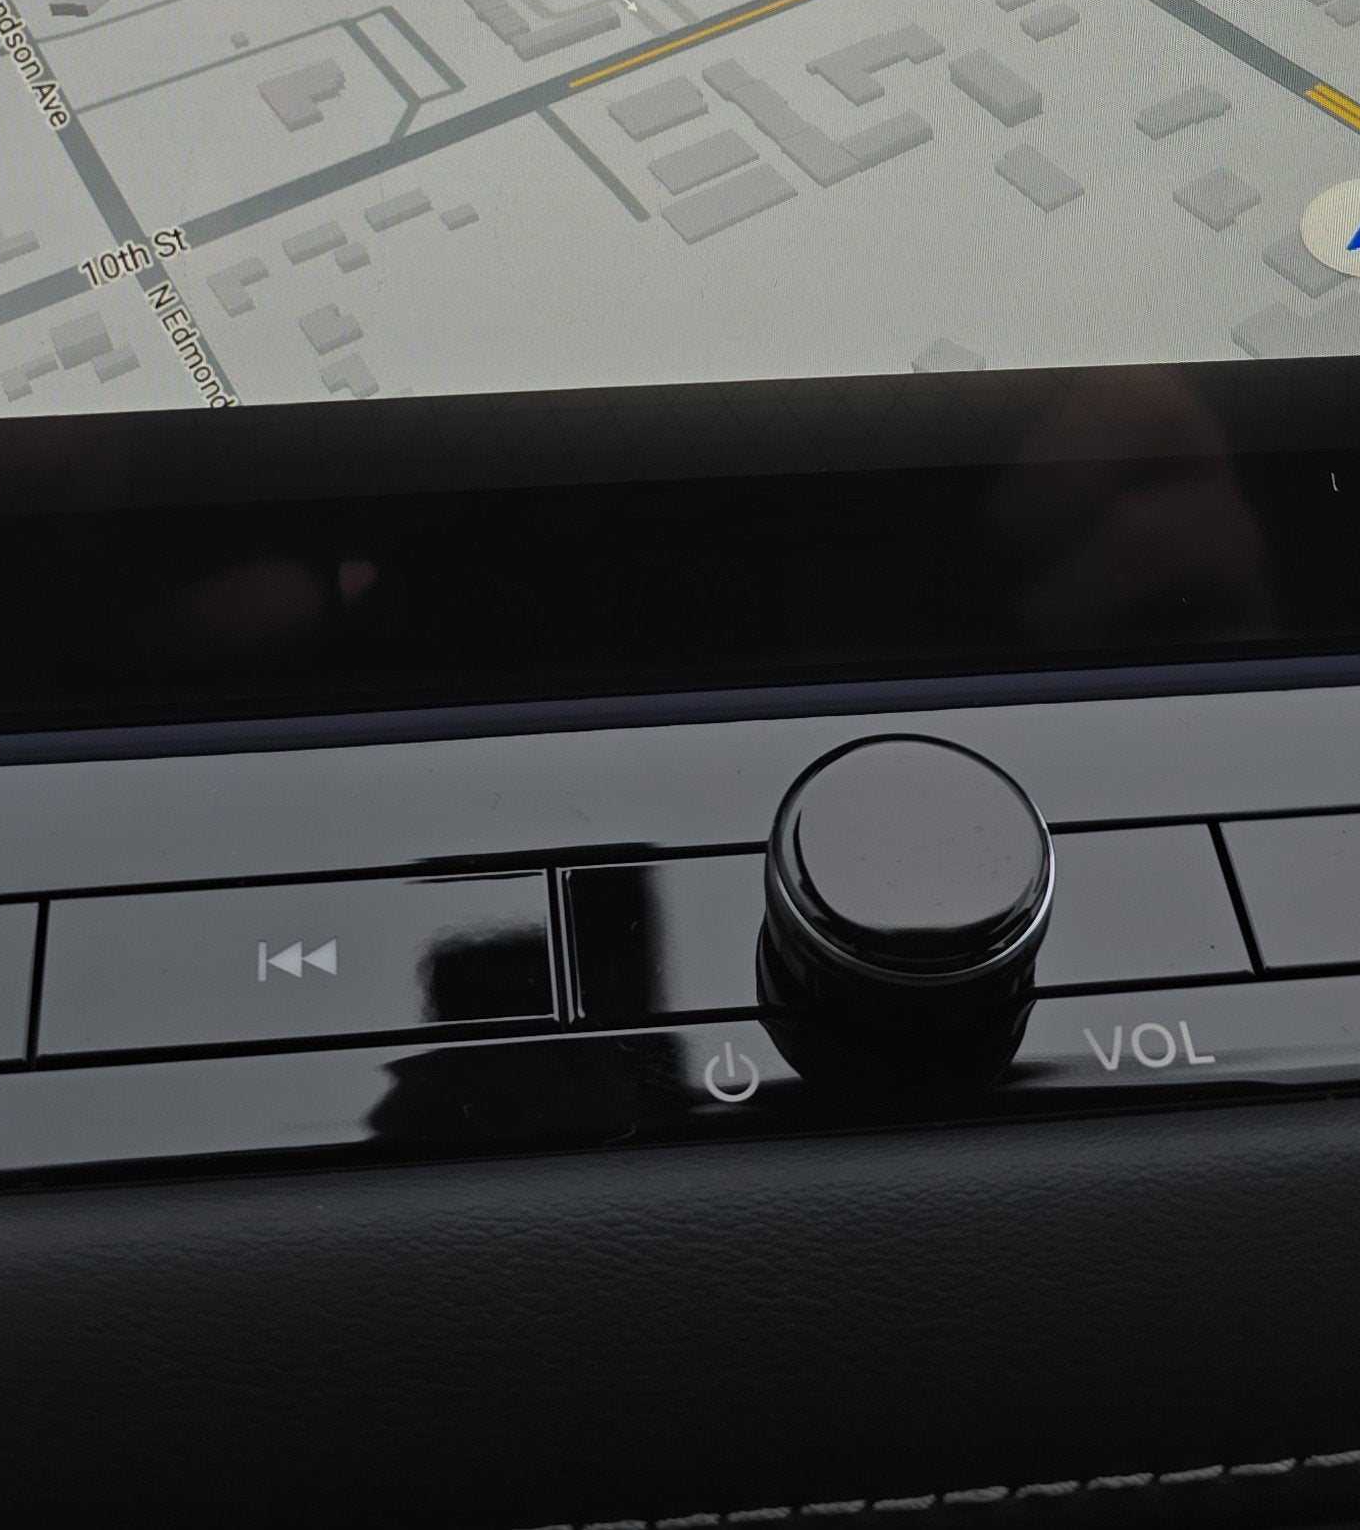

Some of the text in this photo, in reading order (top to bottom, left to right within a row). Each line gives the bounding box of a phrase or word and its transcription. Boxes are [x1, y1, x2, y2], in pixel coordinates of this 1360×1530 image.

[31, 80, 69, 128] Ave
[81, 228, 189, 287] 10th St
[148, 285, 176, 310] N
[1083, 1022, 1216, 1071] VOL
